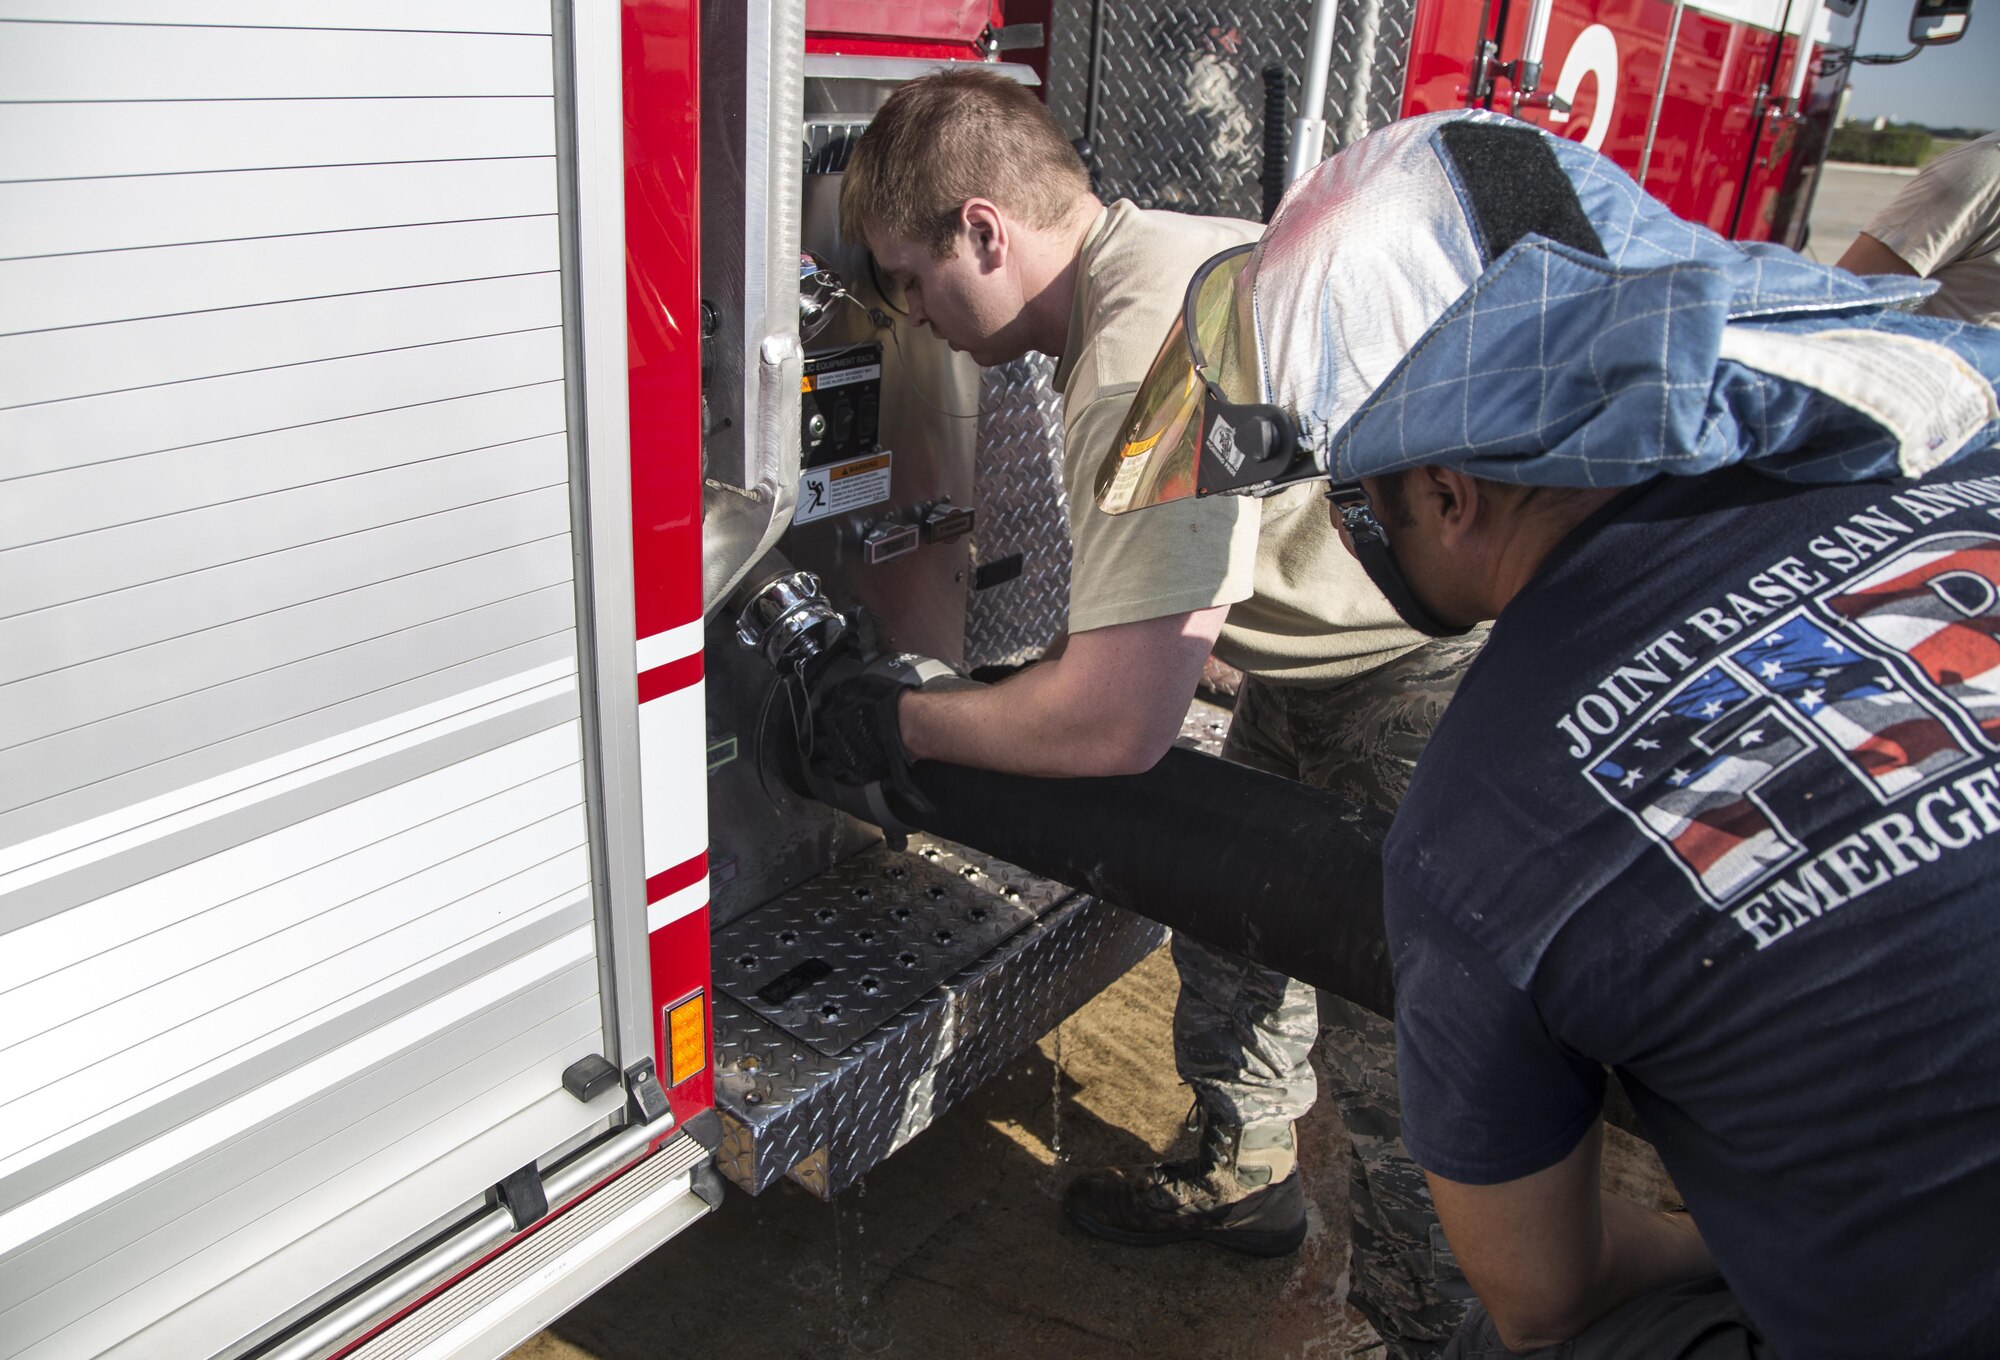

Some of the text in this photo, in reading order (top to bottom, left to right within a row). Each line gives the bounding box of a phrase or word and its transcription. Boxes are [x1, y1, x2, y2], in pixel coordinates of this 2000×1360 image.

[816, 357, 855, 371] EQUIPMENT
[857, 353, 875, 366] RACK
[1556, 630, 1697, 760] JOINT
[1686, 555, 1830, 644] BASE
[1808, 505, 1914, 573] SAN
[1731, 764, 2000, 951] EMERGE
